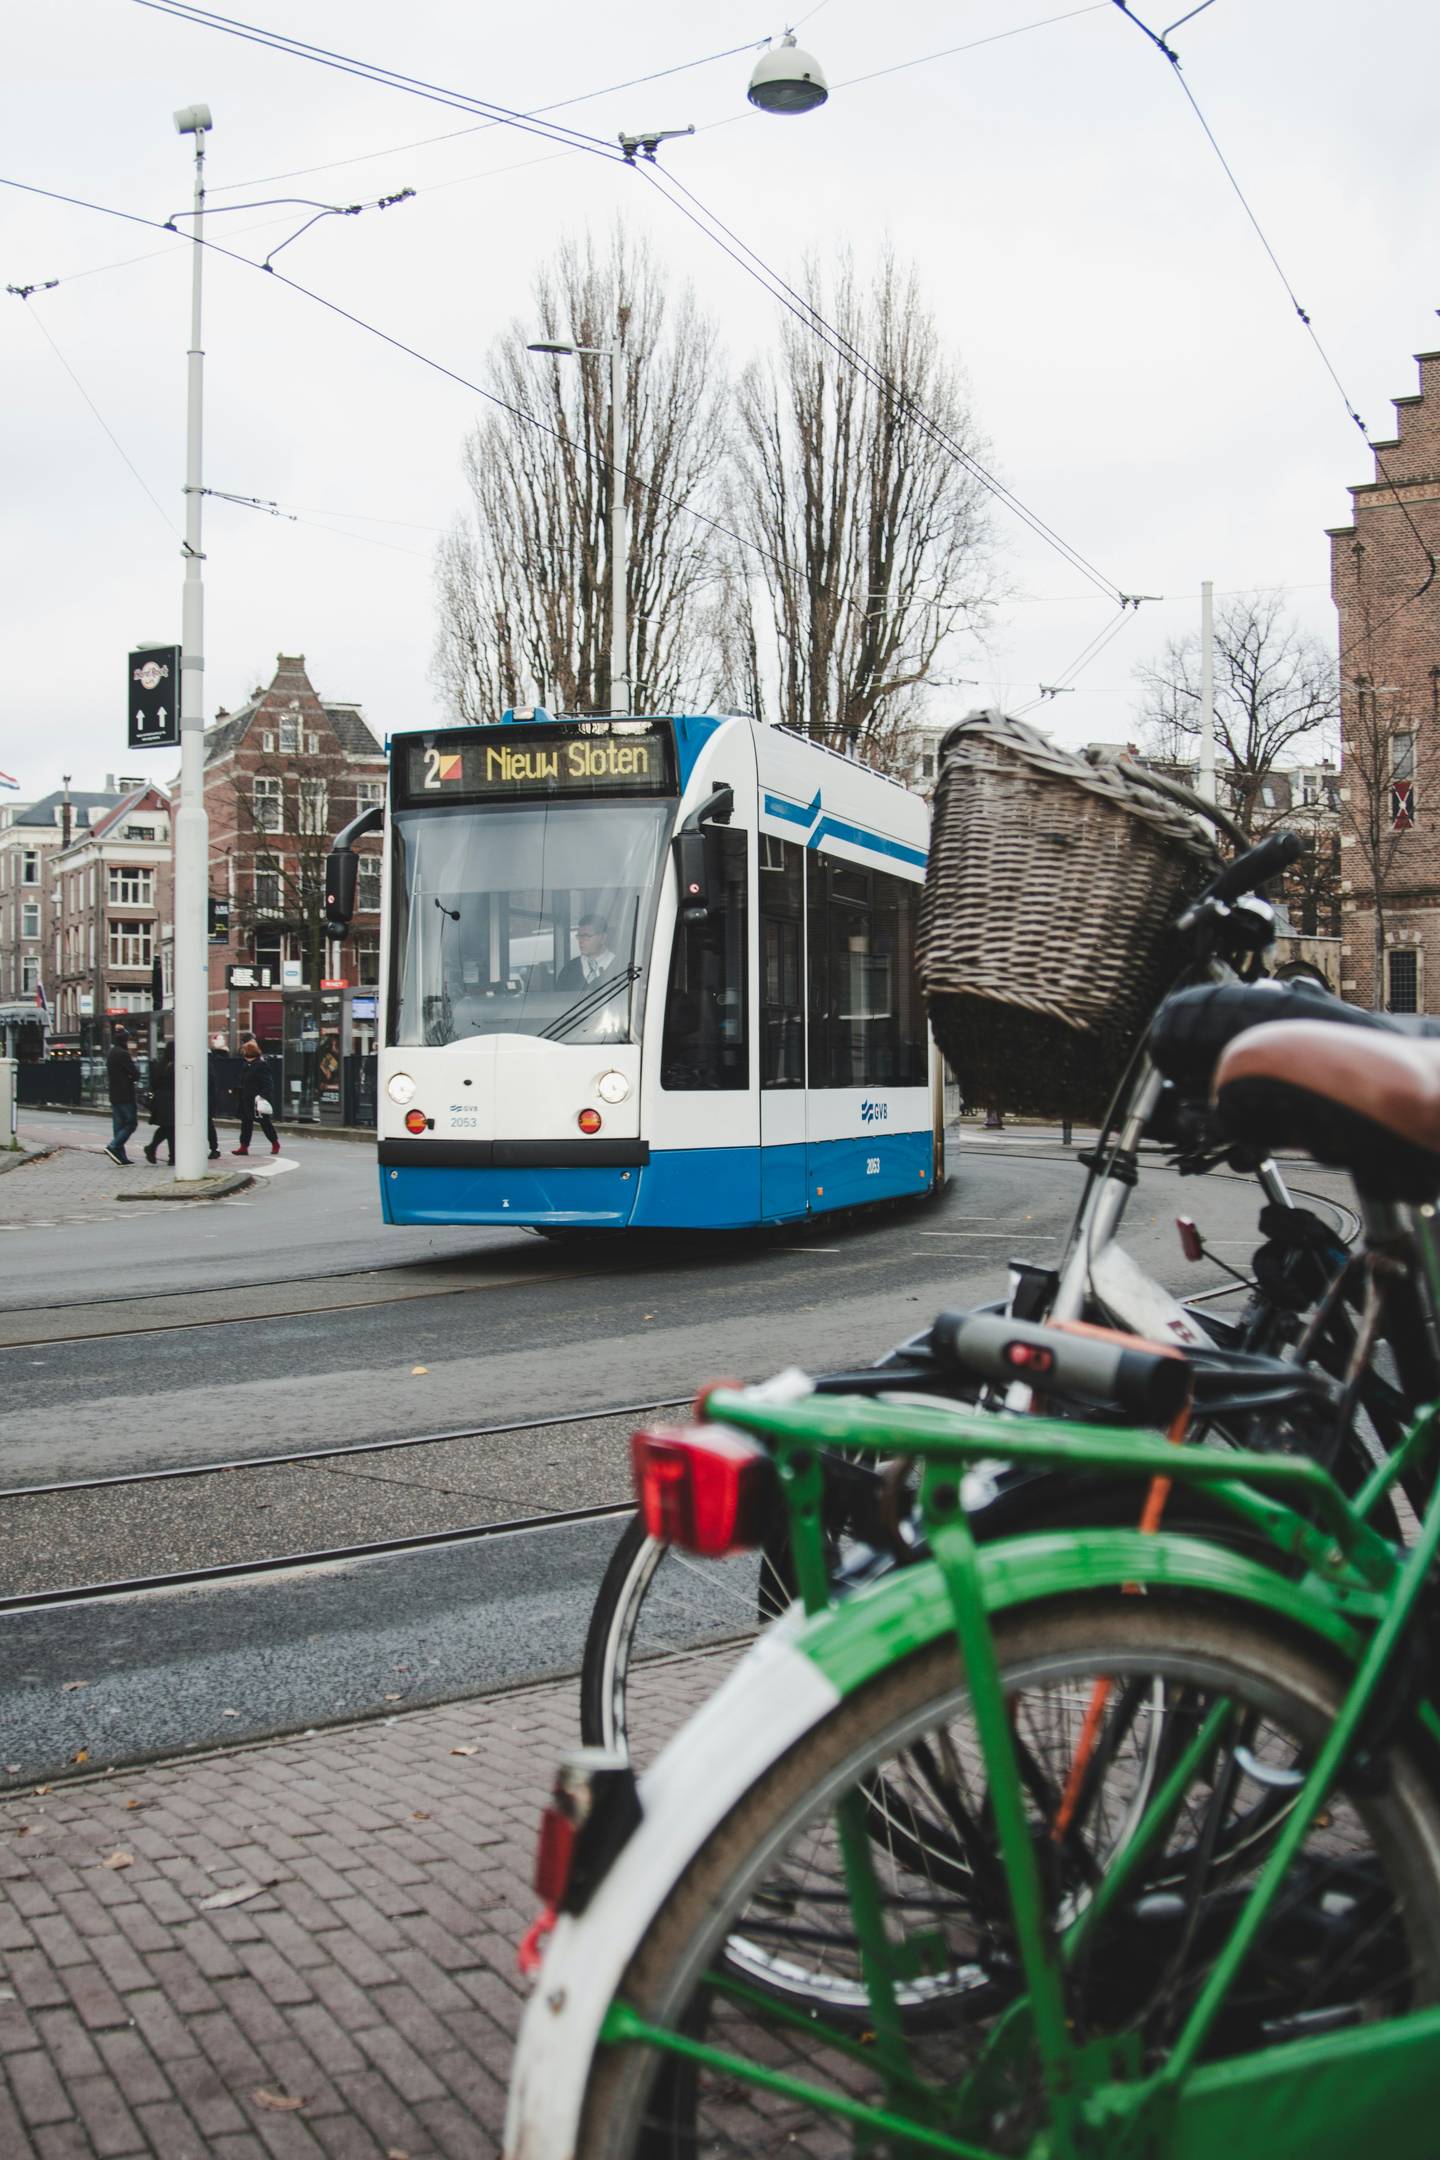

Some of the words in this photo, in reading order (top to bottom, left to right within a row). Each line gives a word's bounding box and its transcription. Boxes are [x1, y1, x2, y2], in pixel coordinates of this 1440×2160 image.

[424, 749, 441, 789] 2
[487, 747, 558, 780] Nieuw
[569, 742, 648, 777] Sloten
[874, 1103, 888, 1120] GVB
[450, 1117, 478, 1128] 2053
[866, 1157, 880, 1175] 2053
